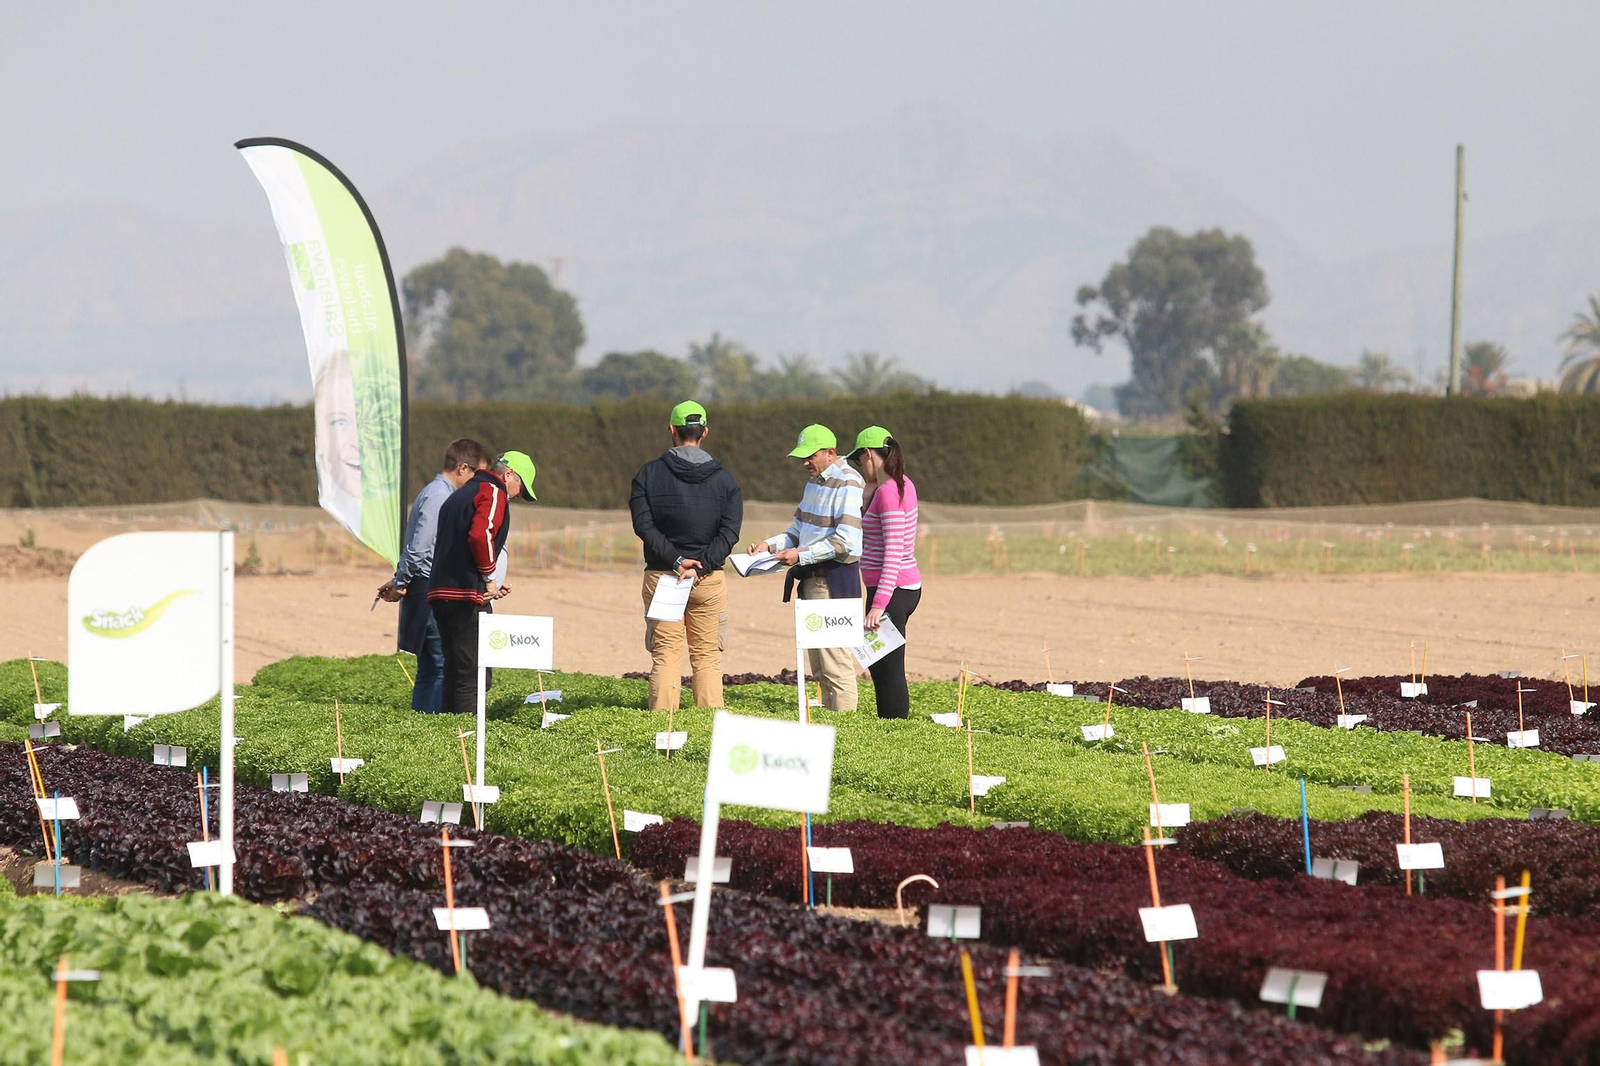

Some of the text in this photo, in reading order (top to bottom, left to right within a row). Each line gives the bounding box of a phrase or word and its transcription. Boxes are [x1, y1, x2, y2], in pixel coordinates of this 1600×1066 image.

[90, 605, 146, 630] Snack
[825, 615, 853, 629] KNOX
[509, 633, 541, 647] KNOX
